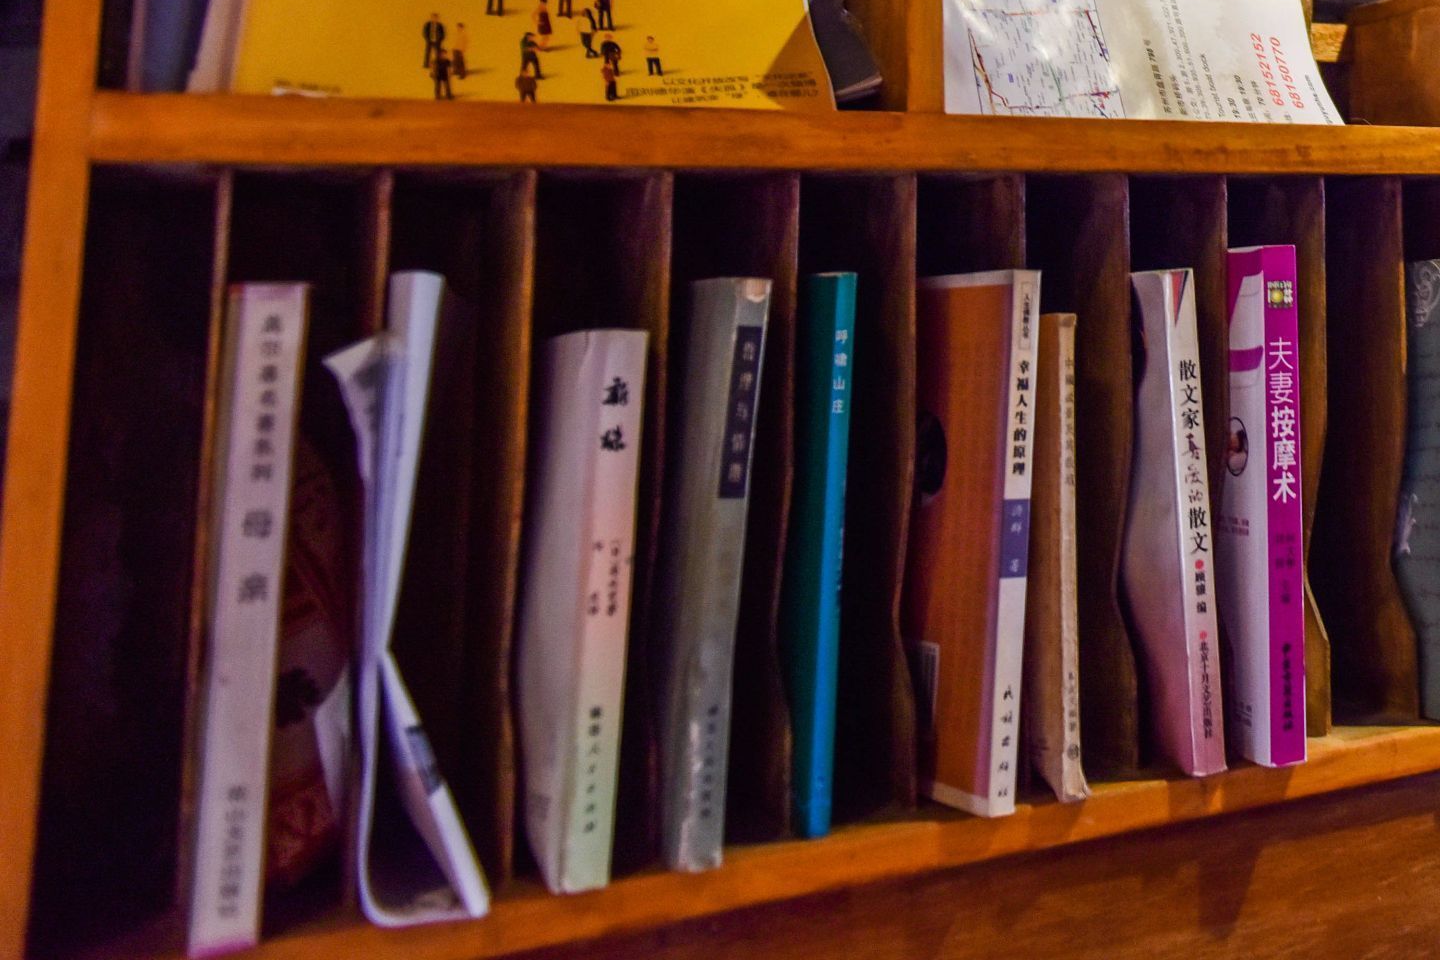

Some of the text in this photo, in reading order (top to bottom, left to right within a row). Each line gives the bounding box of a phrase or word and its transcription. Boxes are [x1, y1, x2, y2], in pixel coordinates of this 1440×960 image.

[1250, 32, 1285, 107] 68152152
[1269, 36, 1305, 109] 68150770
[1012, 360, 1030, 477] 幸福人生的原理
[1268, 336, 1297, 504] 夫妻按摩术
